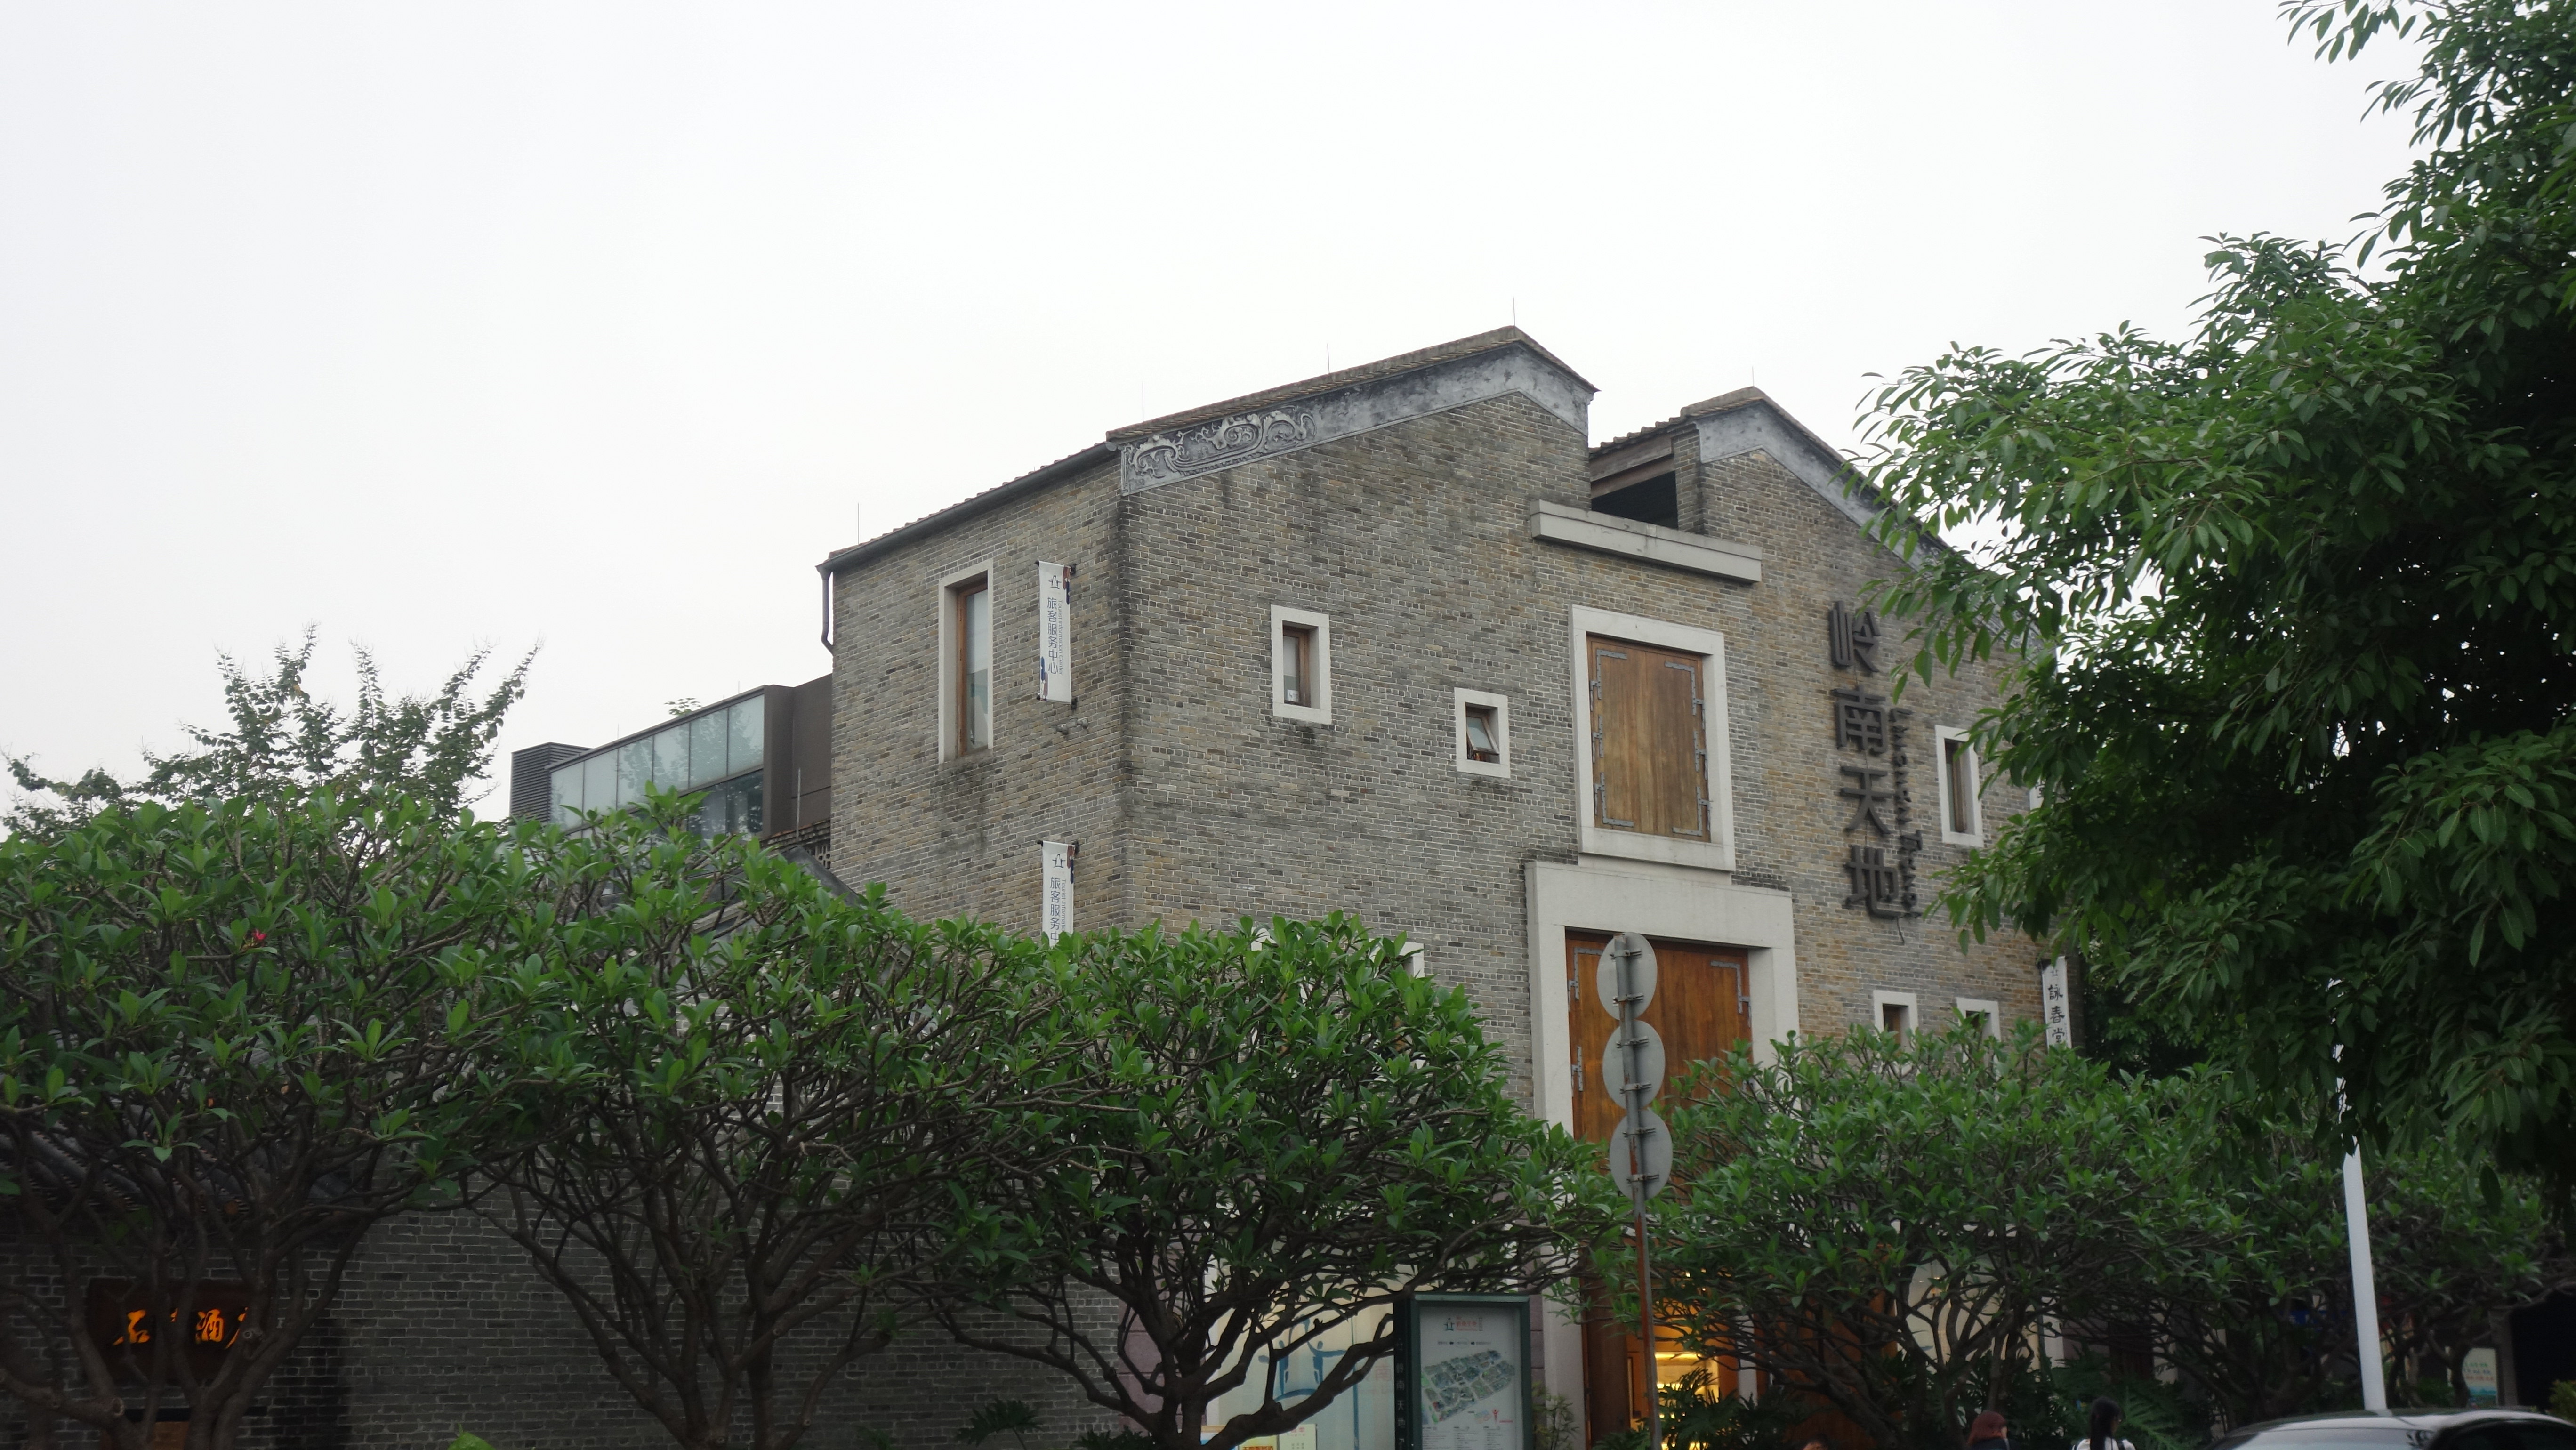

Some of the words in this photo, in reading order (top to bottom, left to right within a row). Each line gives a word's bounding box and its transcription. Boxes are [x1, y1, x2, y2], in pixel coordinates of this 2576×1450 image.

[1047, 596, 1058, 674] 旅客服务中心
[1828, 600, 1903, 919] 岭南天地
[1050, 877, 1061, 943] 旅客服务中
[2047, 984, 2065, 1043] 詠春堂
